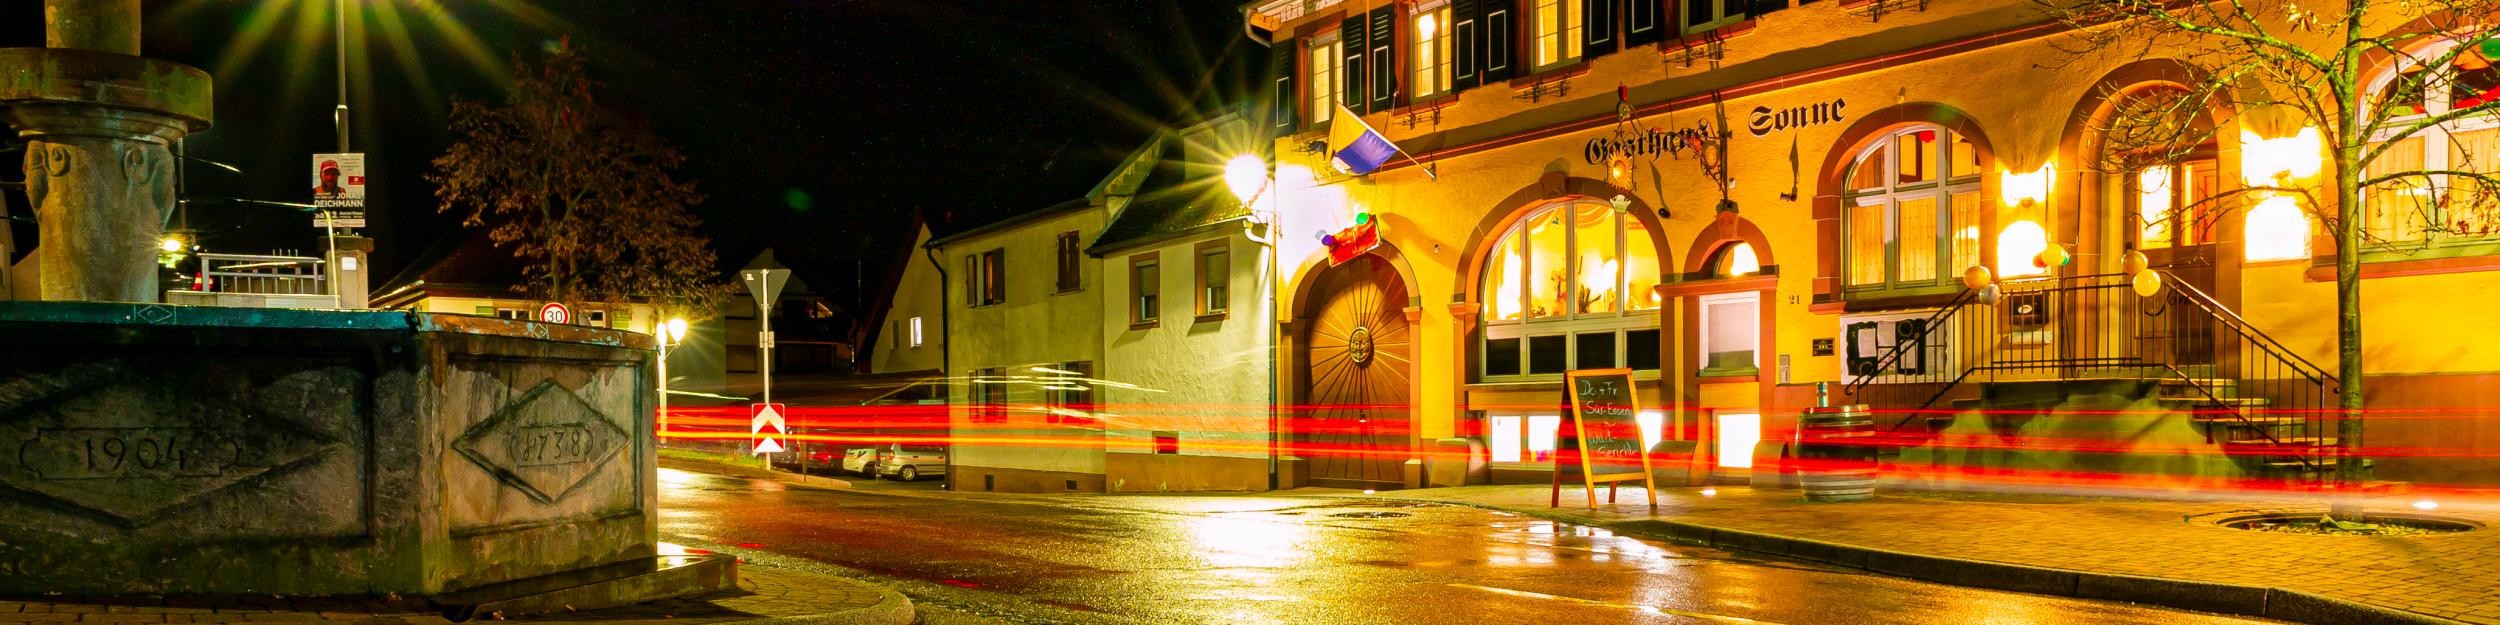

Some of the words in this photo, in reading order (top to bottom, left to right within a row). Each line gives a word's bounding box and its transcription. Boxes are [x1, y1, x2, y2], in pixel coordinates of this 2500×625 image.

[1748, 97, 1847, 137] Sonne
[1789, 294, 1800, 305] 21
[547, 311, 563, 322] 30
[84, 437, 187, 472] 1904
